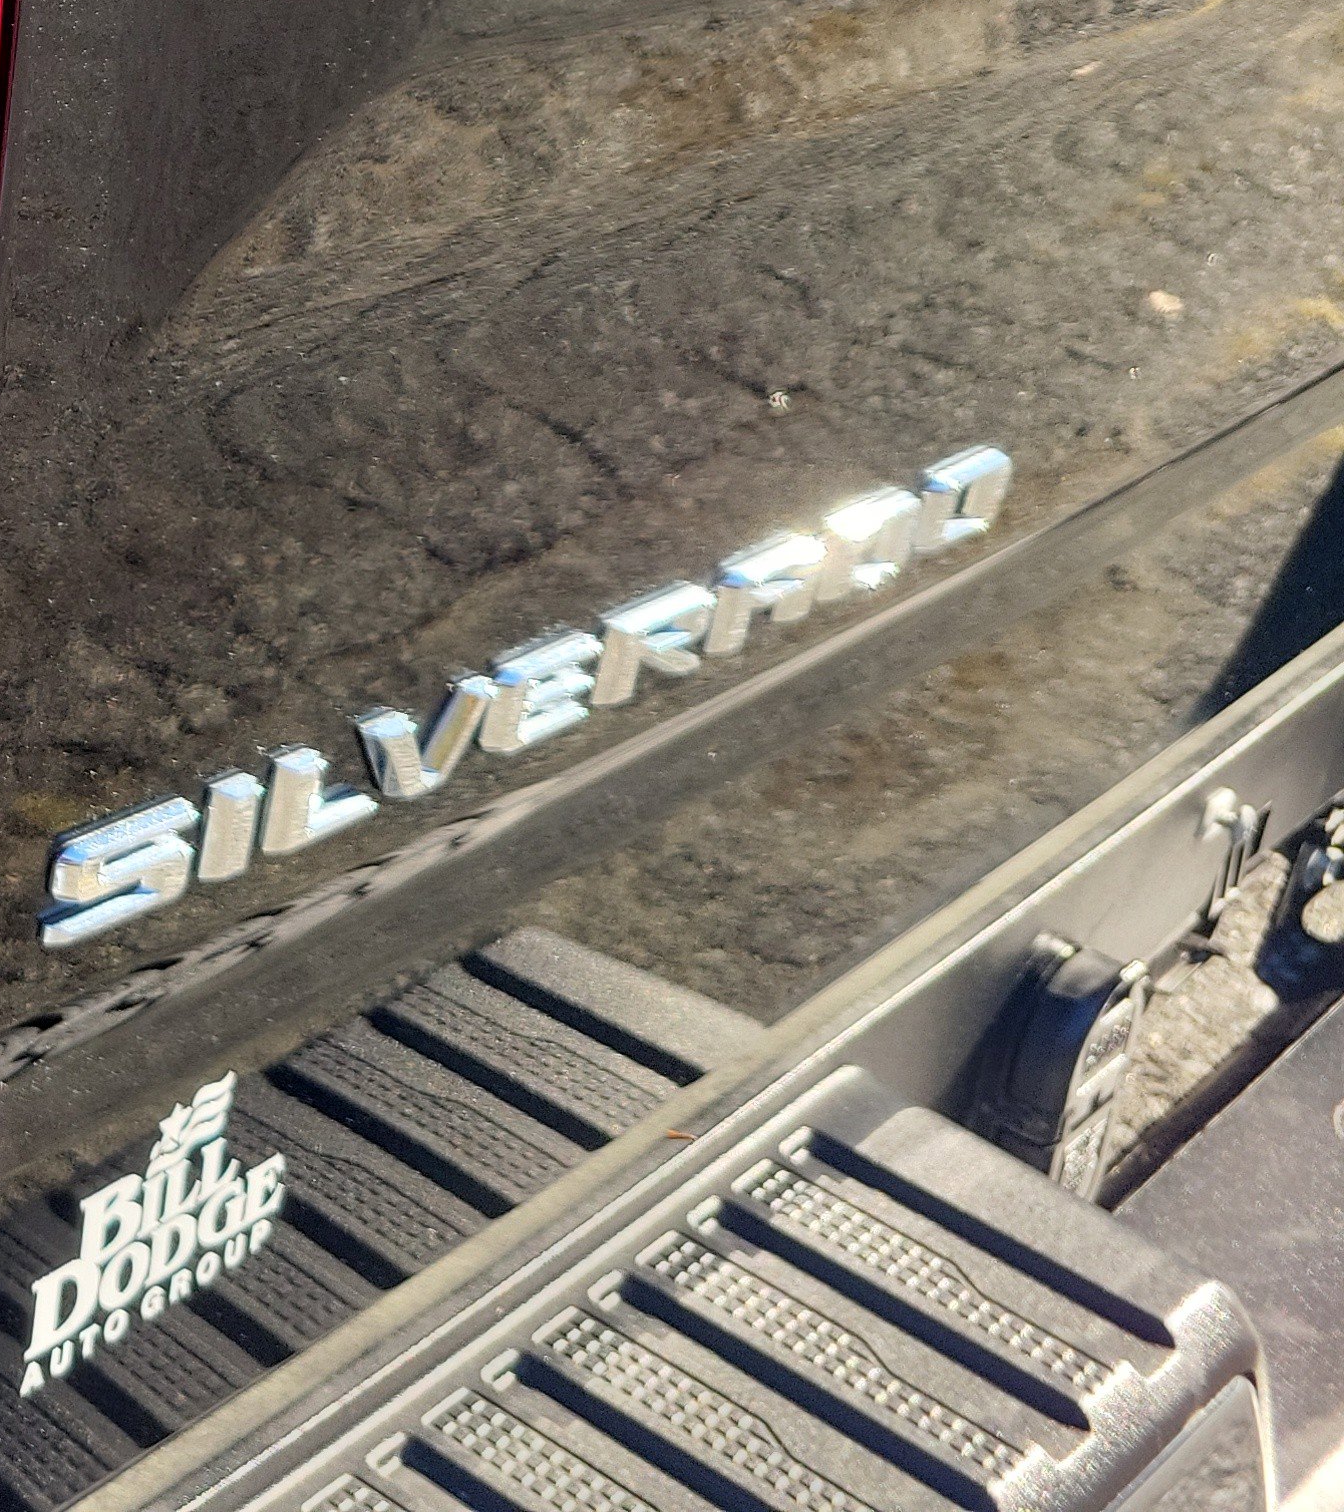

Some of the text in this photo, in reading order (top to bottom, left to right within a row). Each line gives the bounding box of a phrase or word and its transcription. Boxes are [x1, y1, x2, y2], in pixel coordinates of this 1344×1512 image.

[39, 444, 1013, 951] SILVERADO
[23, 1152, 287, 1364] DODGE
[80, 1136, 242, 1266] BILL
